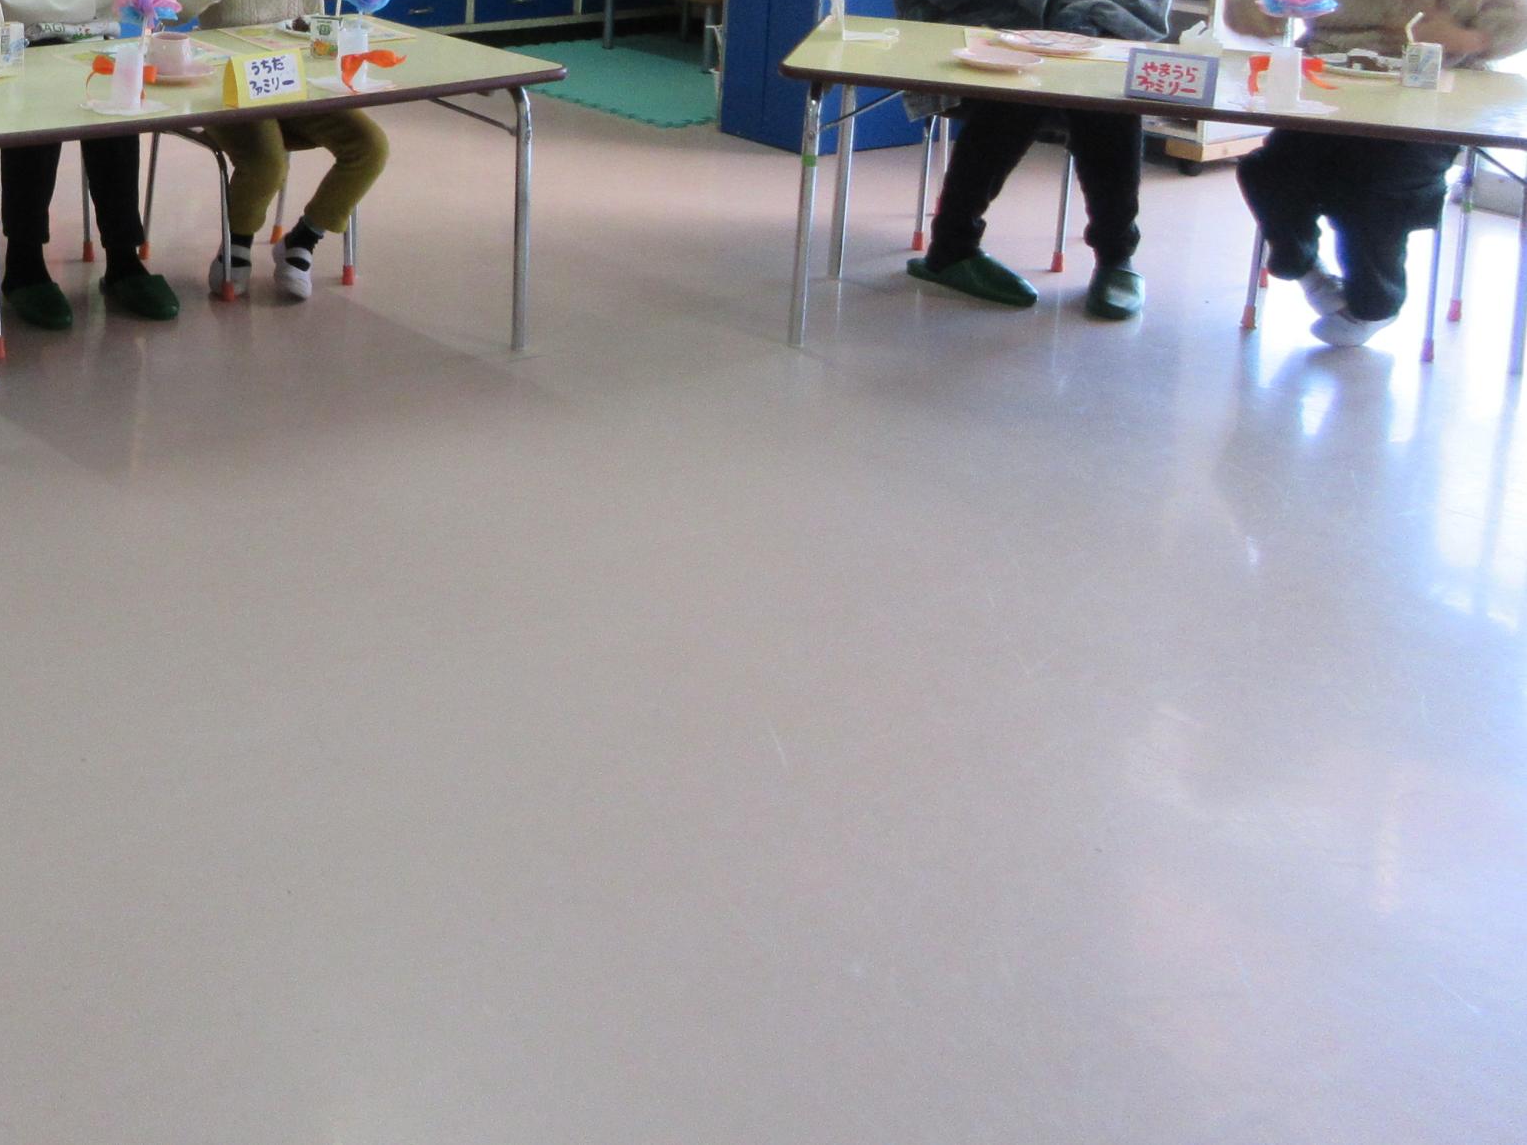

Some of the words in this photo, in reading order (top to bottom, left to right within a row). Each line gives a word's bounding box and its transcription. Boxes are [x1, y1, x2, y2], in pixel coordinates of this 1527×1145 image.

[251, 55, 286, 76] うちだ
[1141, 61, 1199, 83] やまうら
[249, 76, 295, 96] ファミリー
[1135, 75, 1197, 96] ファミリー
